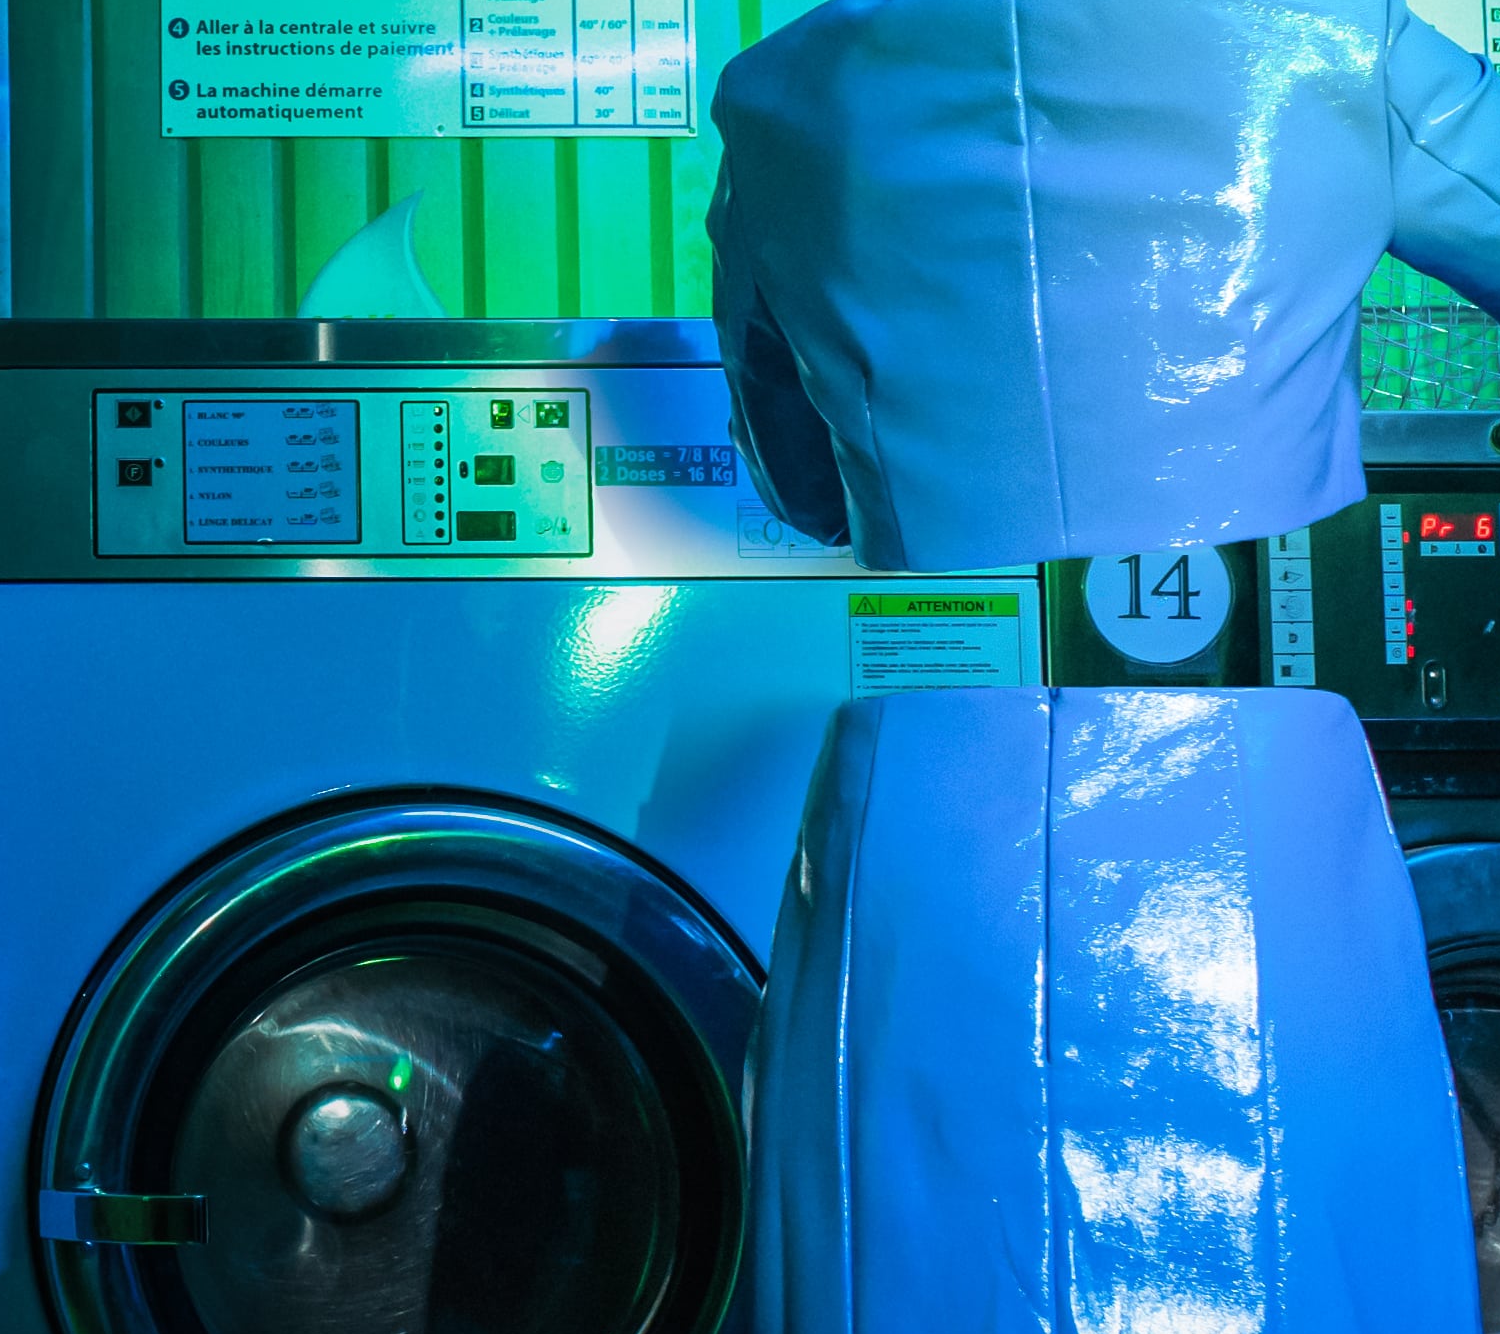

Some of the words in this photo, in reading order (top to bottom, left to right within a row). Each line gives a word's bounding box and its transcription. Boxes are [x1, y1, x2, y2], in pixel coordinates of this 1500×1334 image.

[196, 82, 217, 98] La
[221, 81, 300, 98] machine
[304, 81, 382, 98] démarre
[195, 103, 363, 122] automatiquement
[614, 447, 656, 462] Dose
[677, 447, 703, 463] 7/8
[710, 447, 732, 466] Kg
[599, 466, 610, 481] 2
[616, 466, 666, 482] Doses
[687, 467, 705, 482] 16
[711, 467, 735, 486] Kg
[1475, 517, 1494, 539] 6
[1118, 553, 1201, 622] 14
[907, 599, 985, 613] ATTENTION
